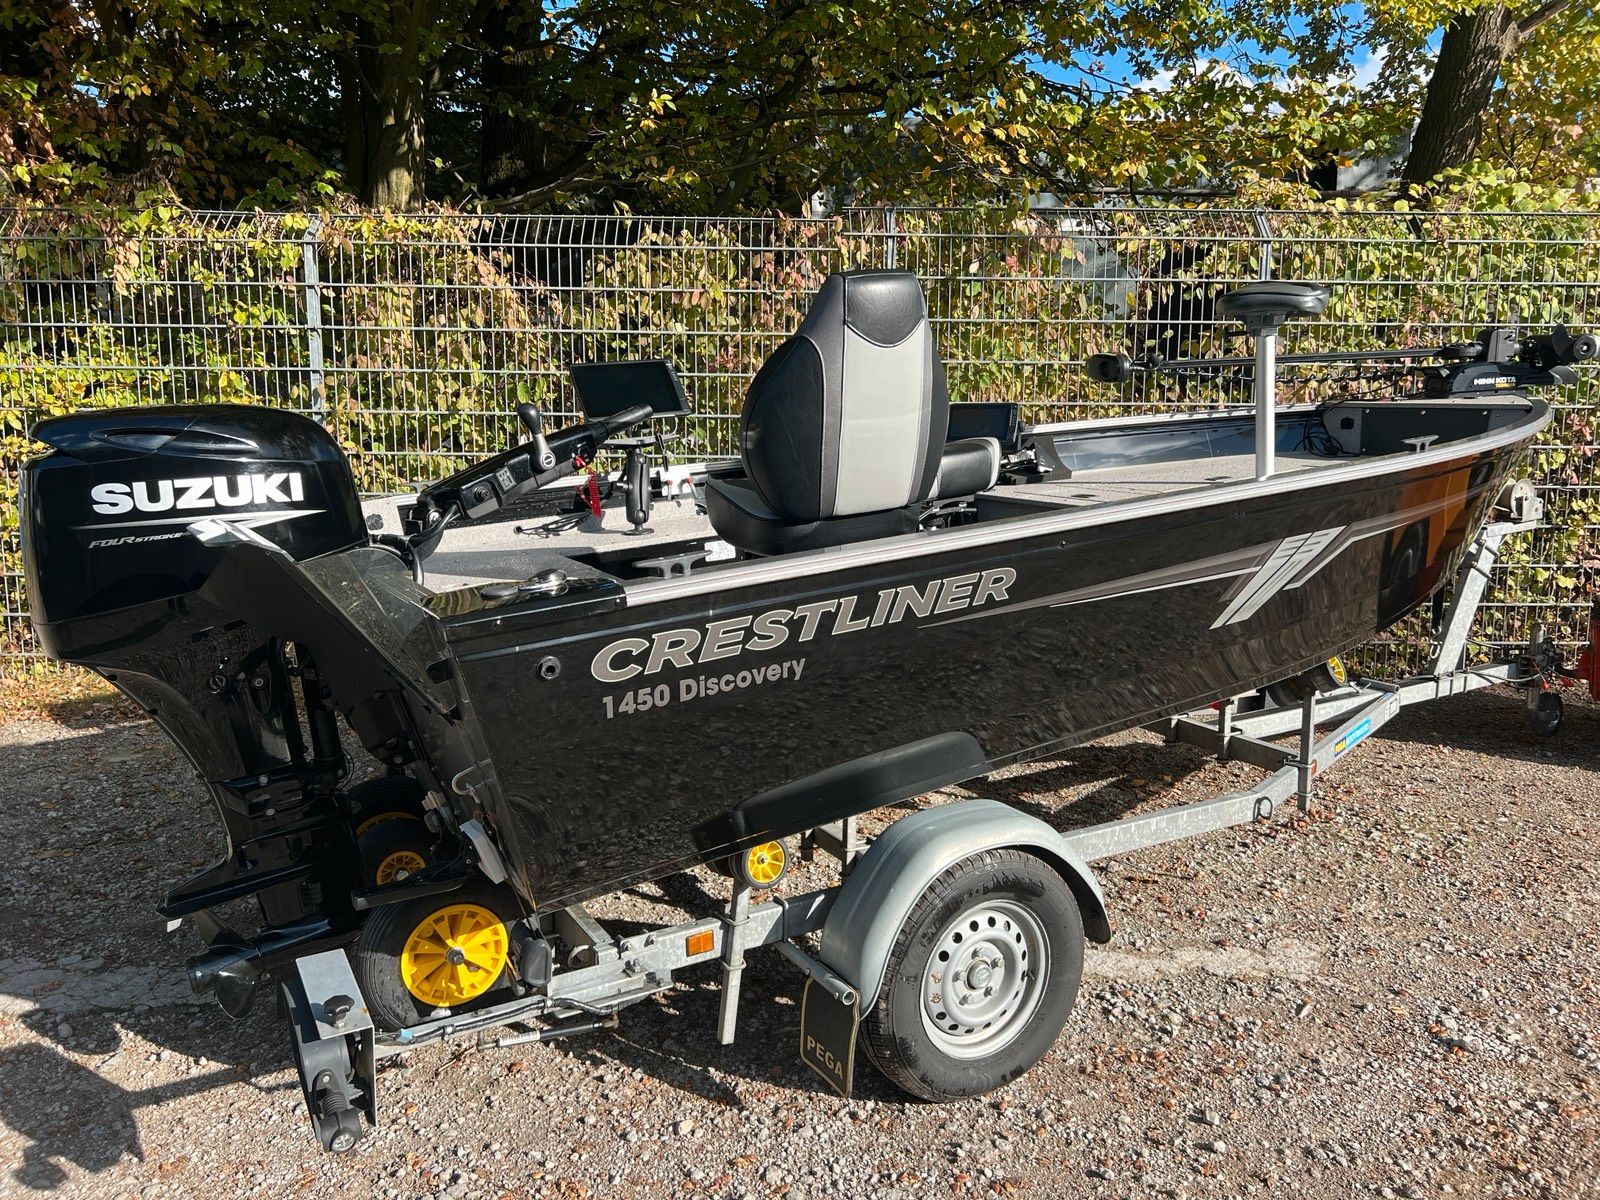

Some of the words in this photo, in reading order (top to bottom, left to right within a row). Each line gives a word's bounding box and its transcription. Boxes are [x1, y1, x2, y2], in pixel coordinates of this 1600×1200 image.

[1473, 377, 1495, 385] MINN
[91, 472, 304, 514] SUZUKI
[88, 535, 135, 549] FOUR
[590, 566, 1017, 683] CRESTLINER
[602, 683, 670, 719] 1450
[679, 658, 806, 704] Discovery
[807, 1035, 843, 1080] PEGA
